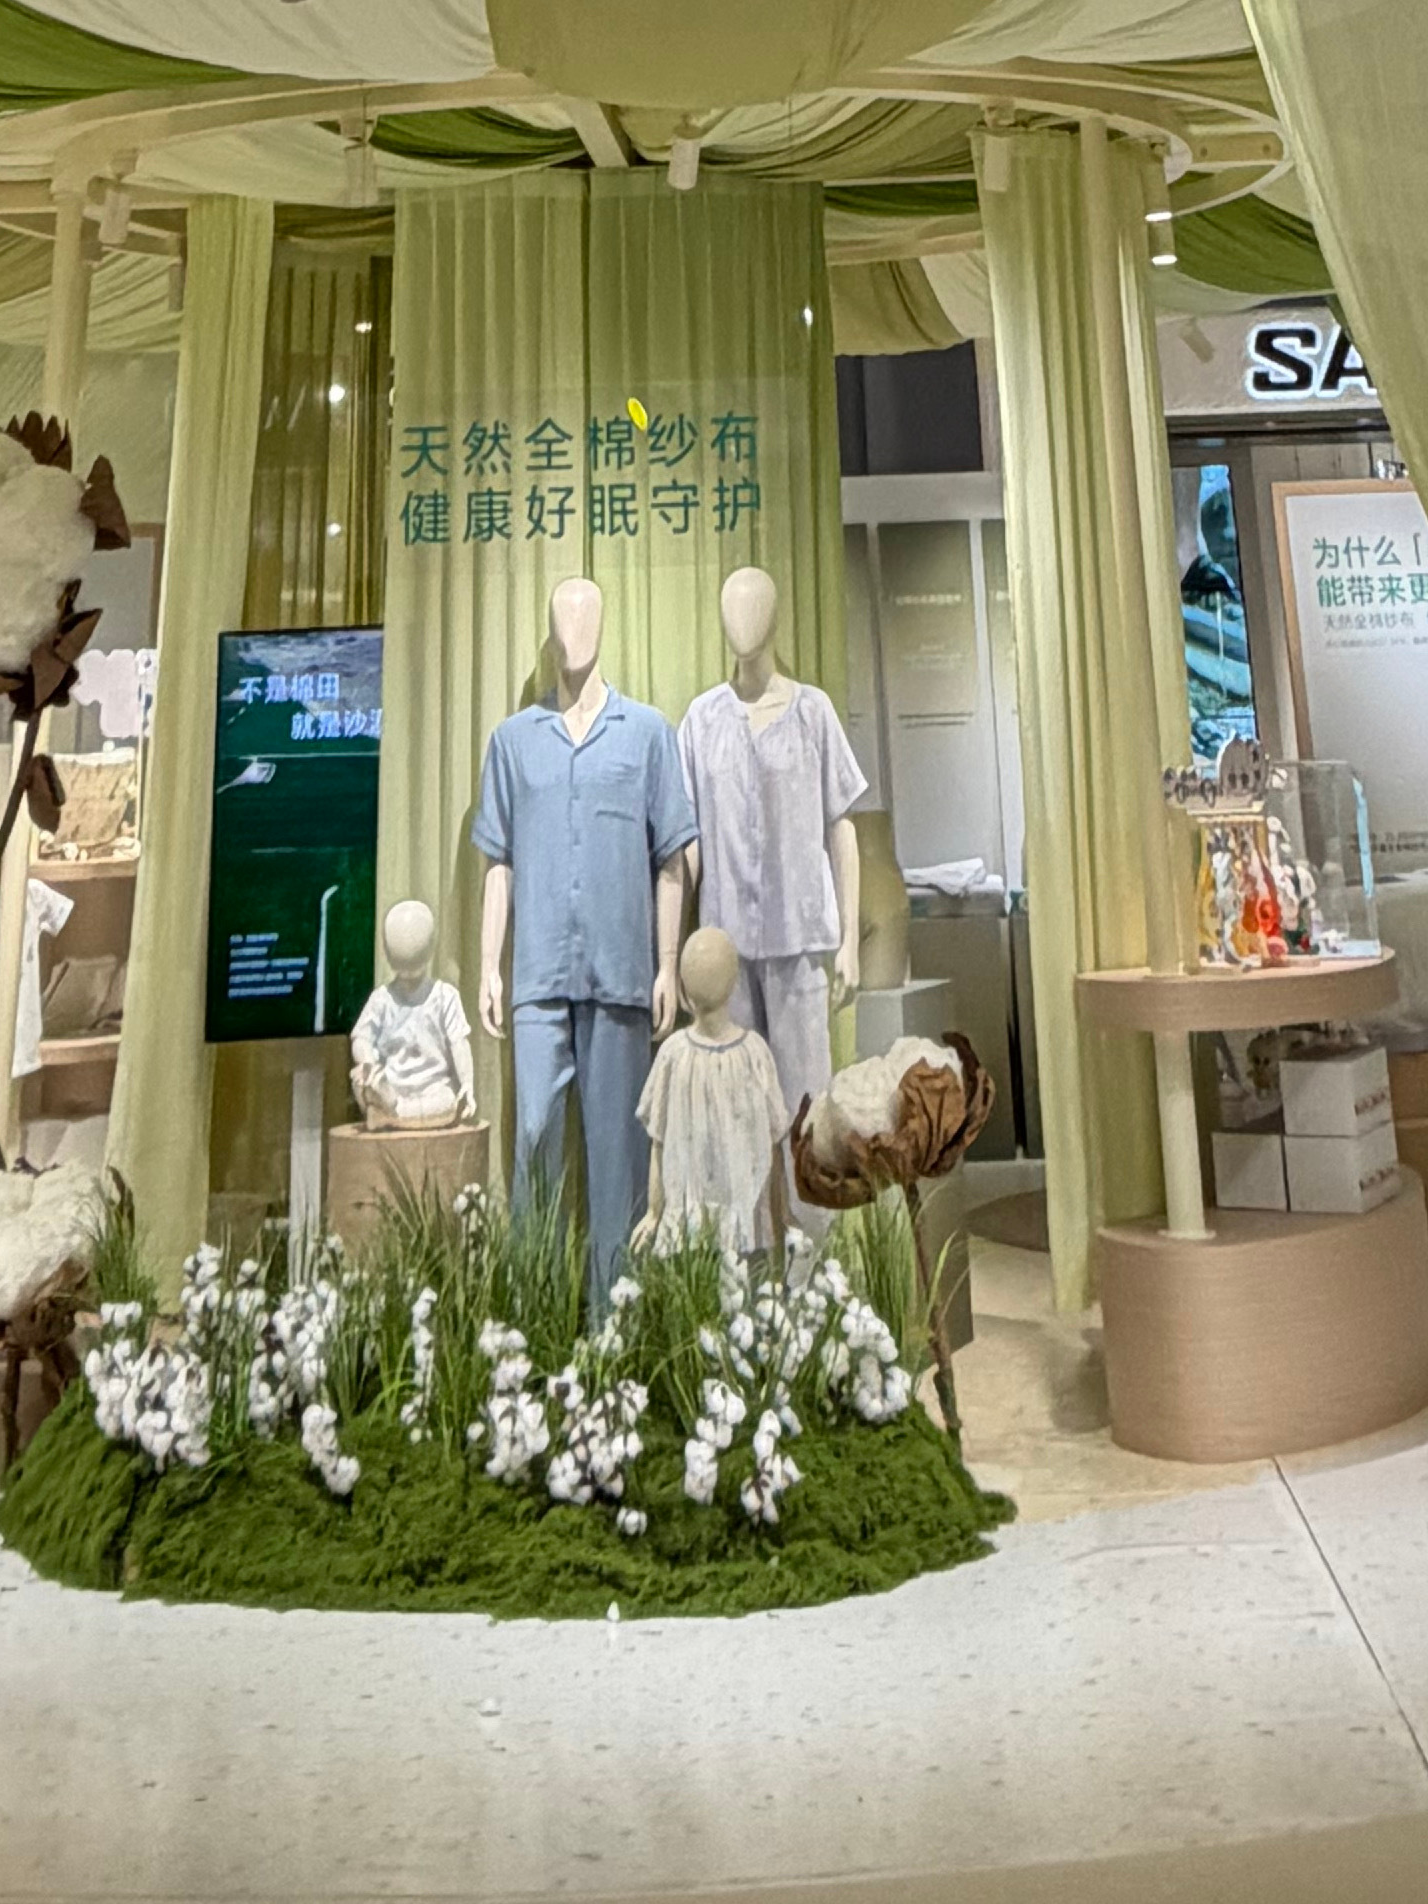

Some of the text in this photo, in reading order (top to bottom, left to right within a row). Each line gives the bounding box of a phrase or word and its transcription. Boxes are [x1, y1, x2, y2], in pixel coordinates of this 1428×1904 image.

[400, 410, 760, 479] 天然全棉纱布
[399, 476, 761, 547] 健康好眠守护
